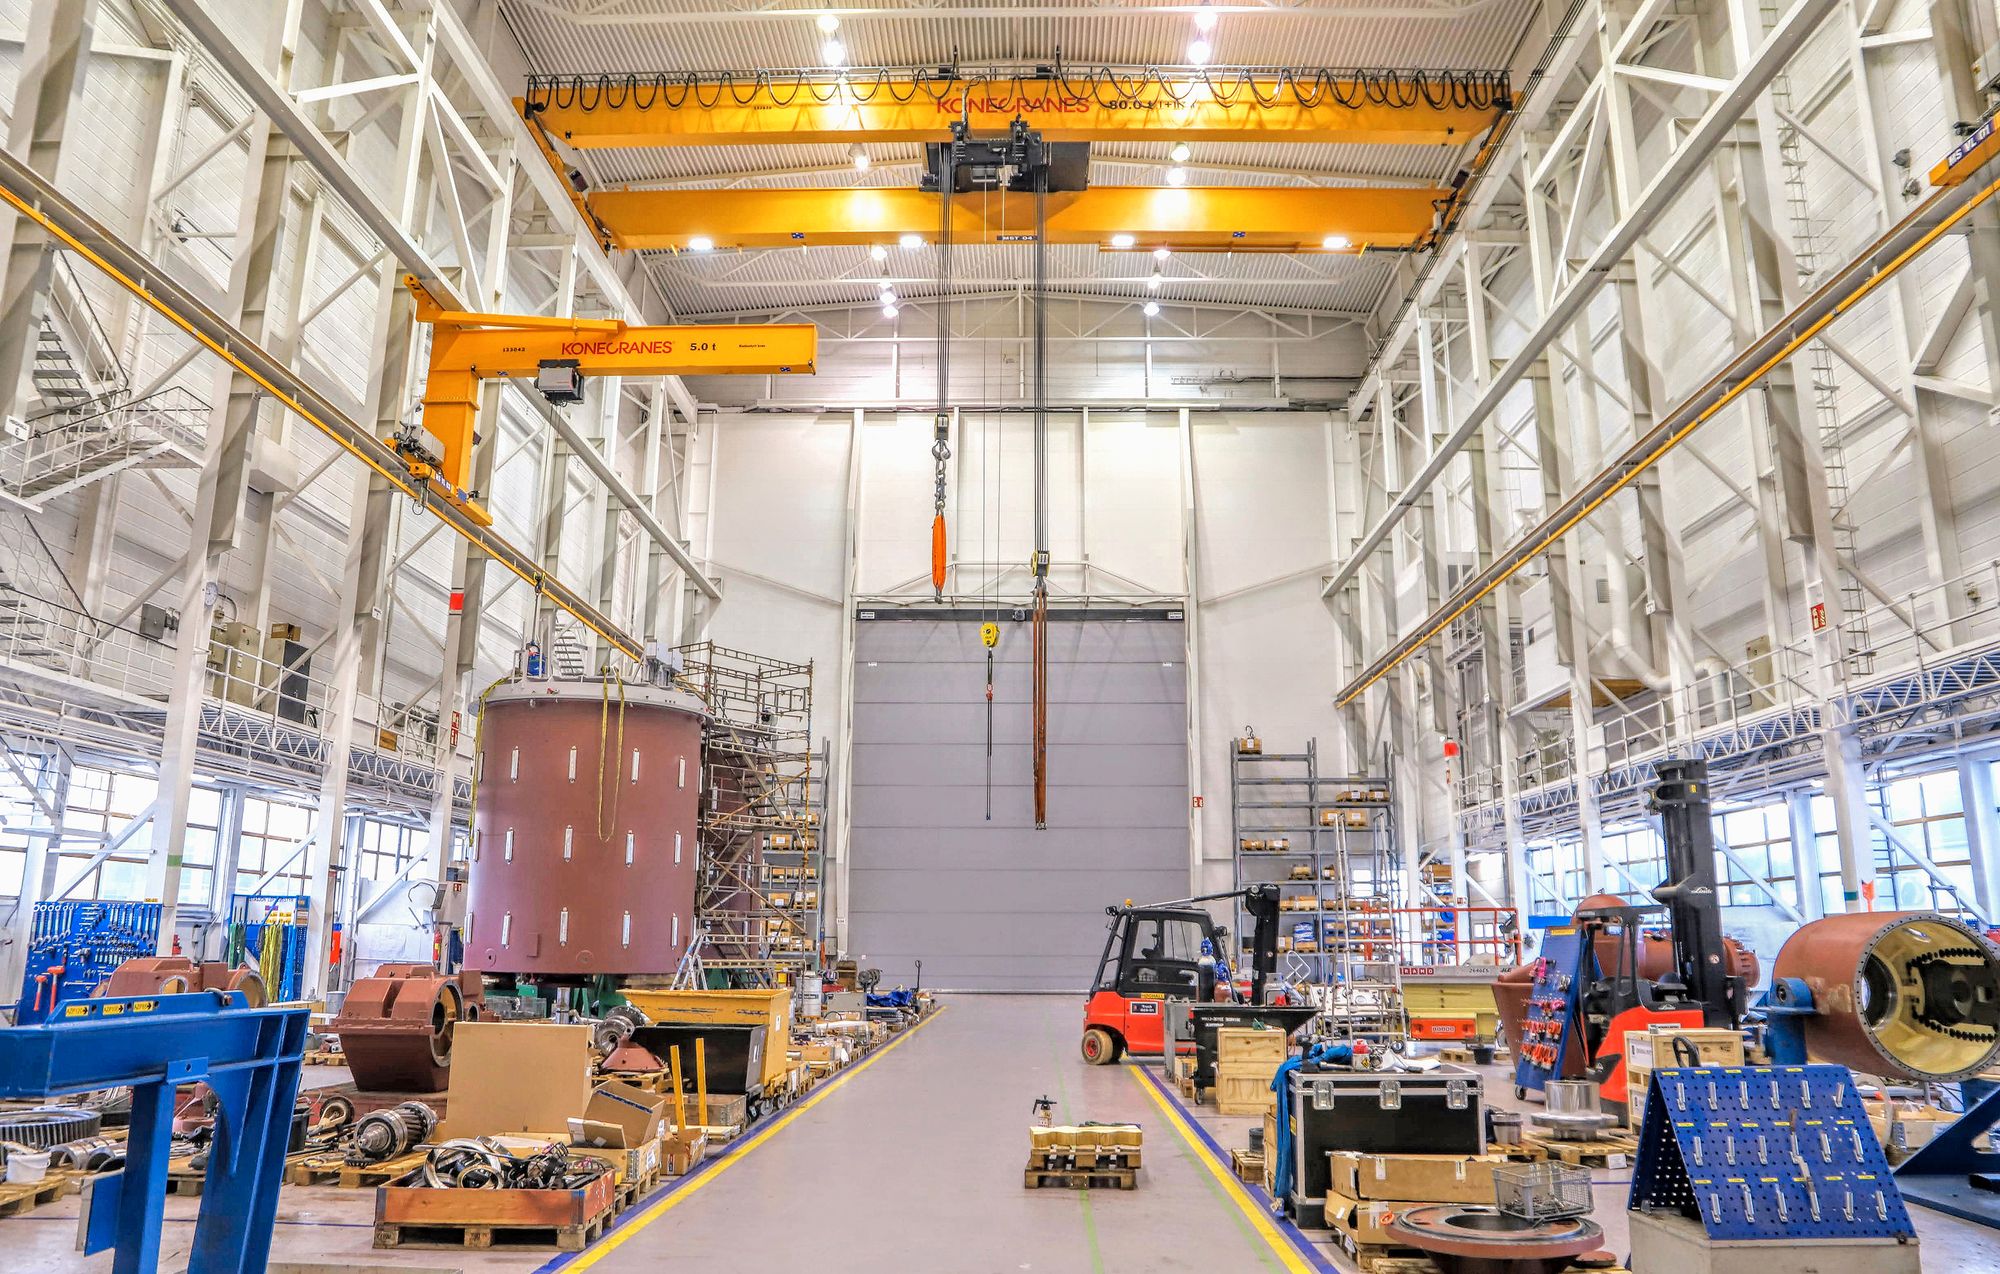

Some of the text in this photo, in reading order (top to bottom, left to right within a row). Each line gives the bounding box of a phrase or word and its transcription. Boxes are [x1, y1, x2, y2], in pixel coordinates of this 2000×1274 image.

[937, 97, 1090, 113] KONECRANES
[561, 341, 673, 355] KONECRANES
[690, 343, 717, 351] 5.0 t
